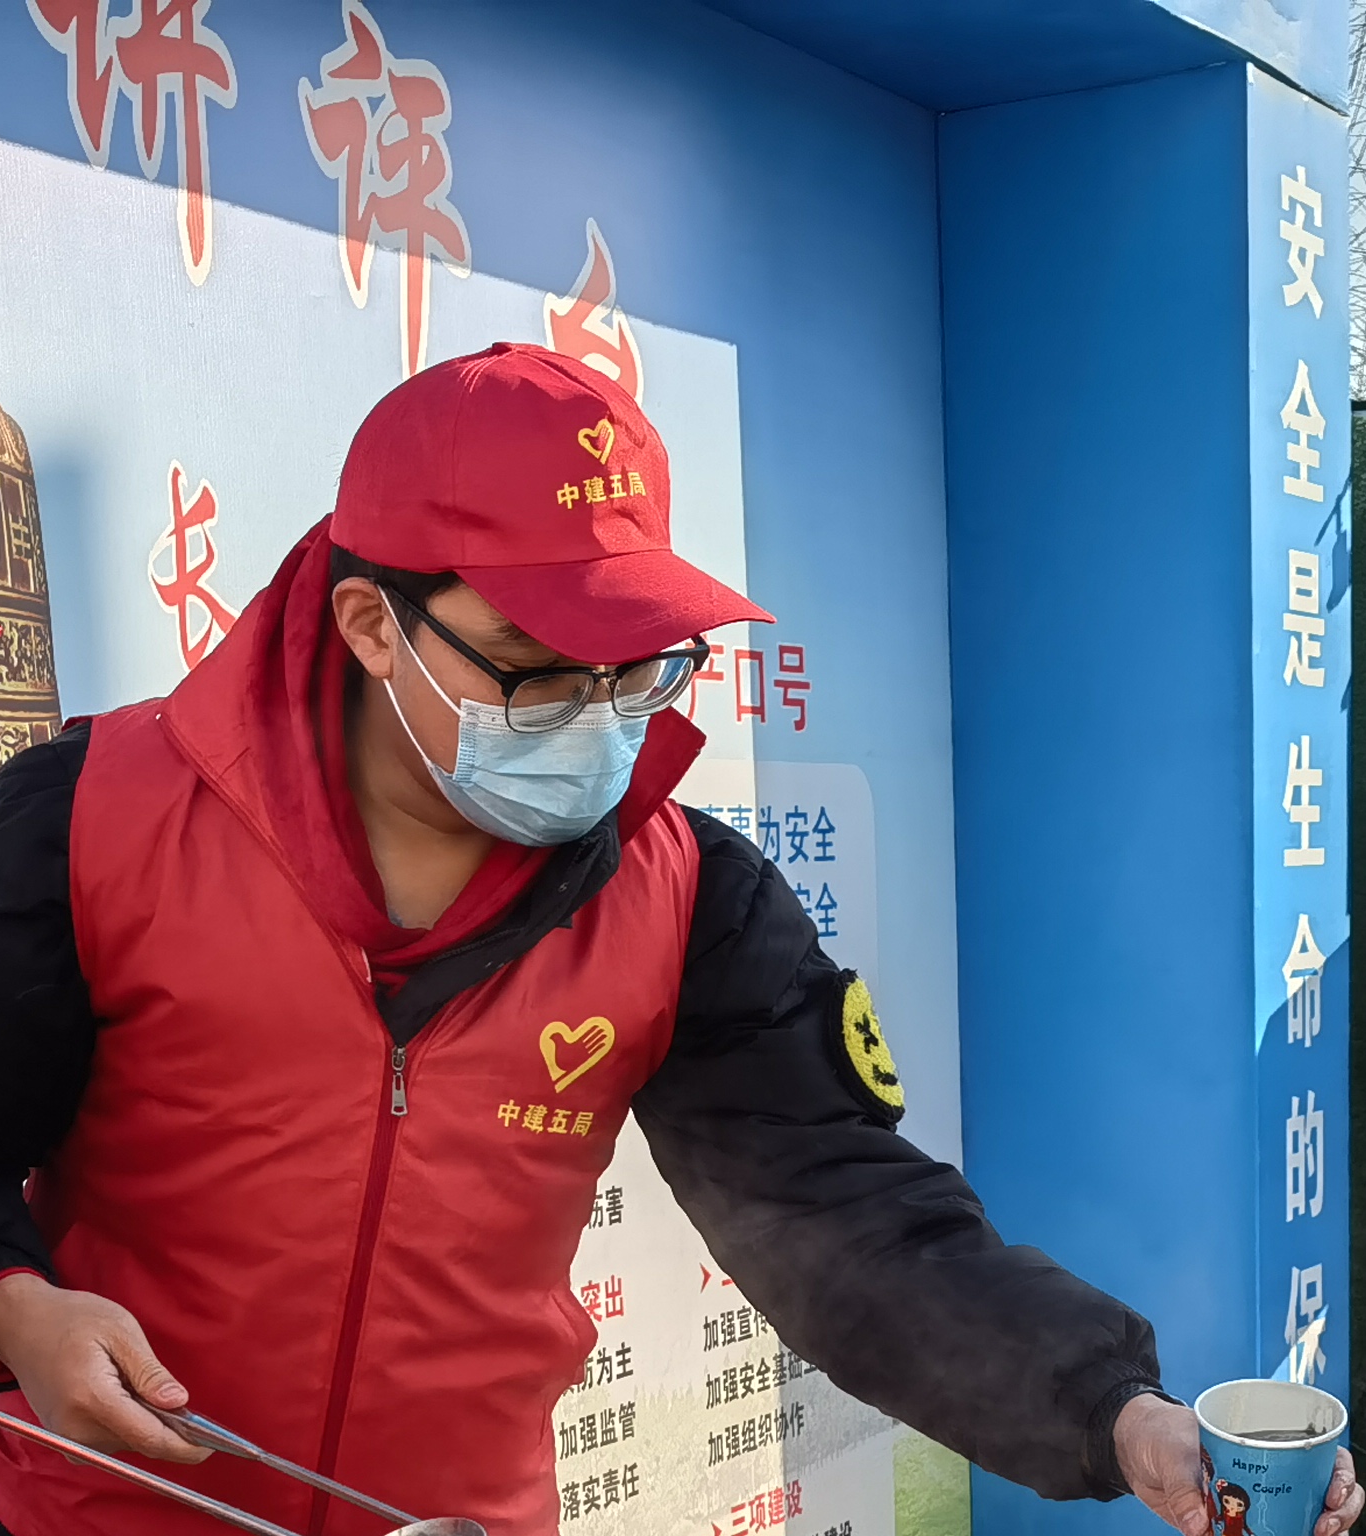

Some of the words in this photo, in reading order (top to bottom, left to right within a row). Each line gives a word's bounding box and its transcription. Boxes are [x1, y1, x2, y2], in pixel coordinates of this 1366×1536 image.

[556, 471, 647, 509] 中建五局
[497, 1099, 594, 1137] 中建五局
[580, 1274, 625, 1323] 突出
[559, 1401, 637, 1460] 加强监管
[708, 1401, 805, 1467] 加强组织协作
[1232, 1458, 1269, 1474] Happy
[561, 1462, 640, 1522] 落实责任
[1252, 1483, 1292, 1495] Couple
